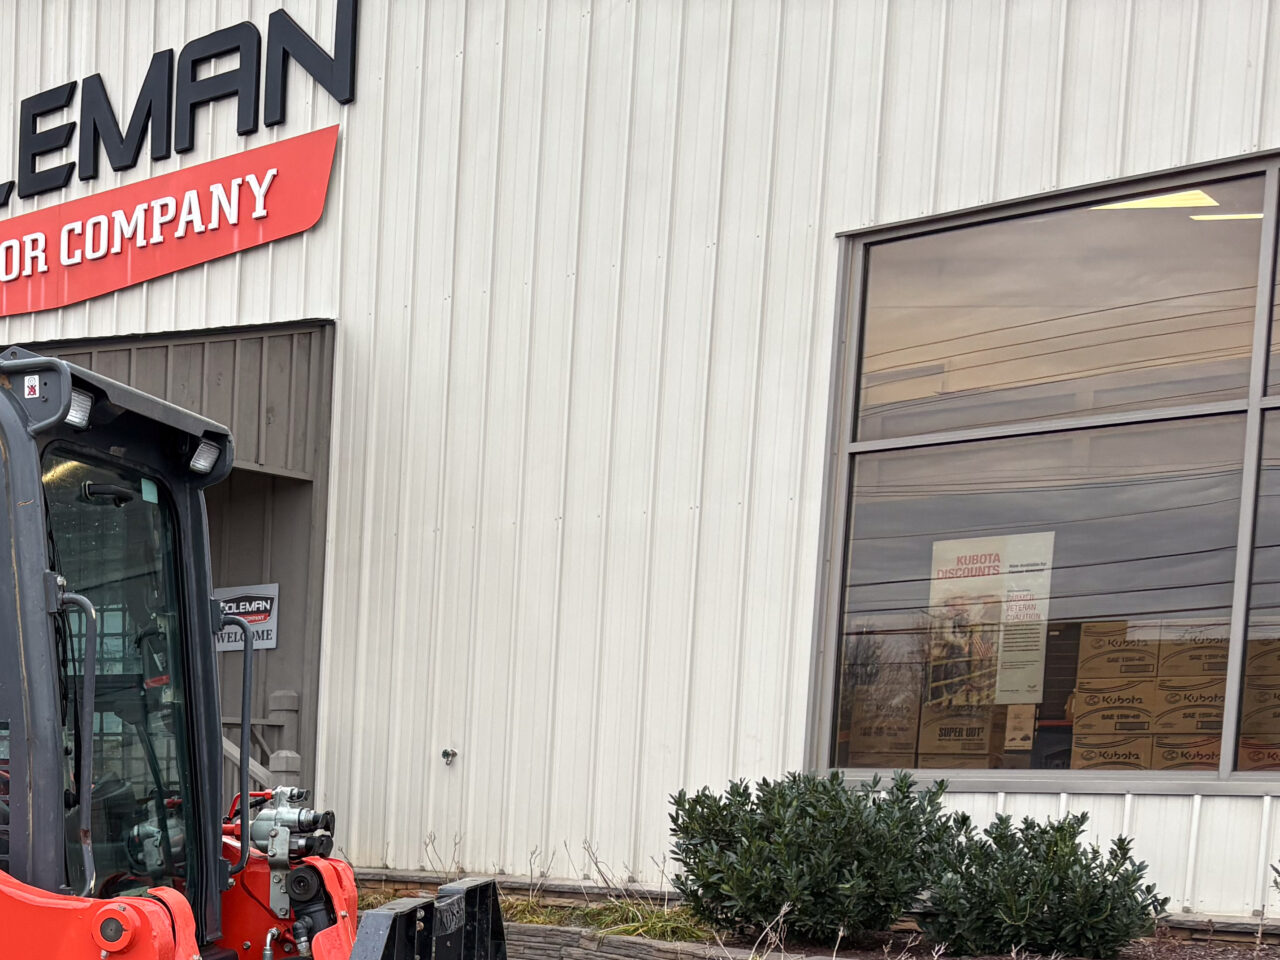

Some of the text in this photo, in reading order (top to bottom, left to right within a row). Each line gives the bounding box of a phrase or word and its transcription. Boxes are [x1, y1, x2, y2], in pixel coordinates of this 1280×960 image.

[59, 168, 278, 266] COMPANY
[956, 553, 1000, 566] KUBOTA
[936, 565, 1000, 580] DISCOUNTS
[1102, 695, 1144, 704] Kubota
[938, 727, 963, 738] SUPER
[1099, 750, 1140, 760] Kubota
